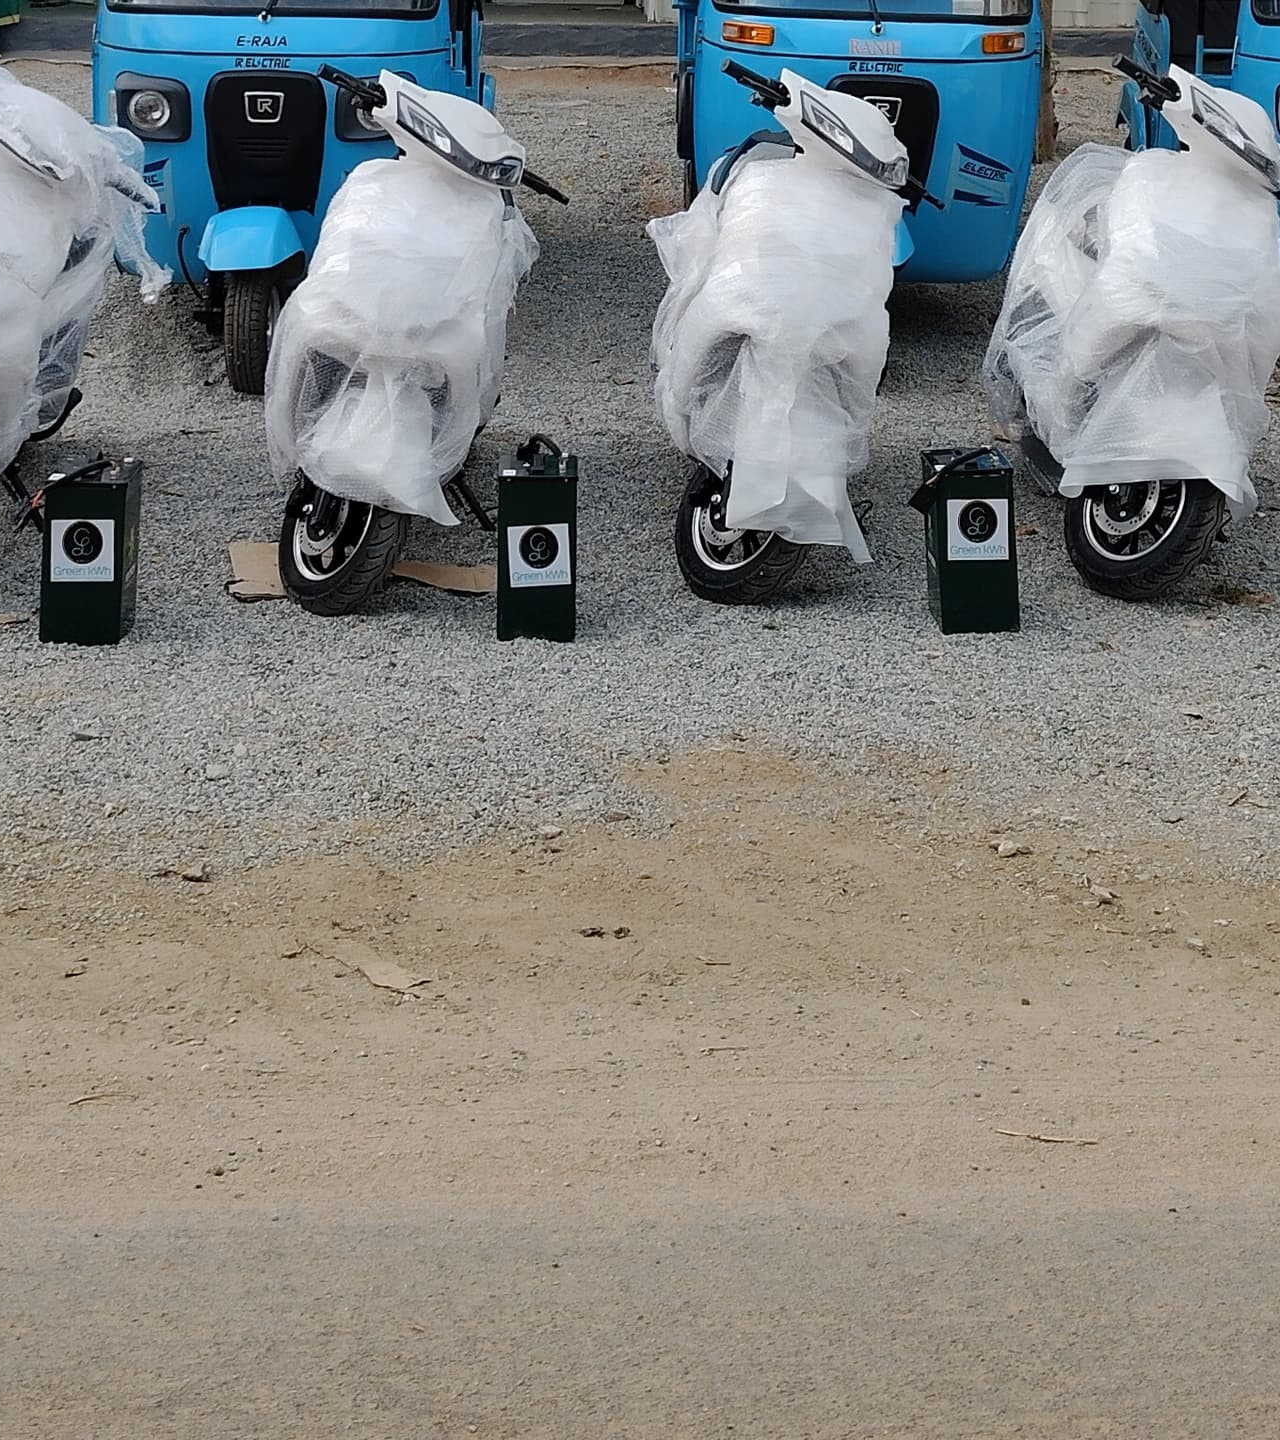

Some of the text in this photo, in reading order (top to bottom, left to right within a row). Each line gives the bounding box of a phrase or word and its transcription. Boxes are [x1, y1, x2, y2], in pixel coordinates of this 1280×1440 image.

[236, 35, 288, 47] E-RAJA
[950, 544, 1007, 556] Green kWh
[54, 566, 112, 577] Green kWh
[512, 569, 569, 582] Green kWh
